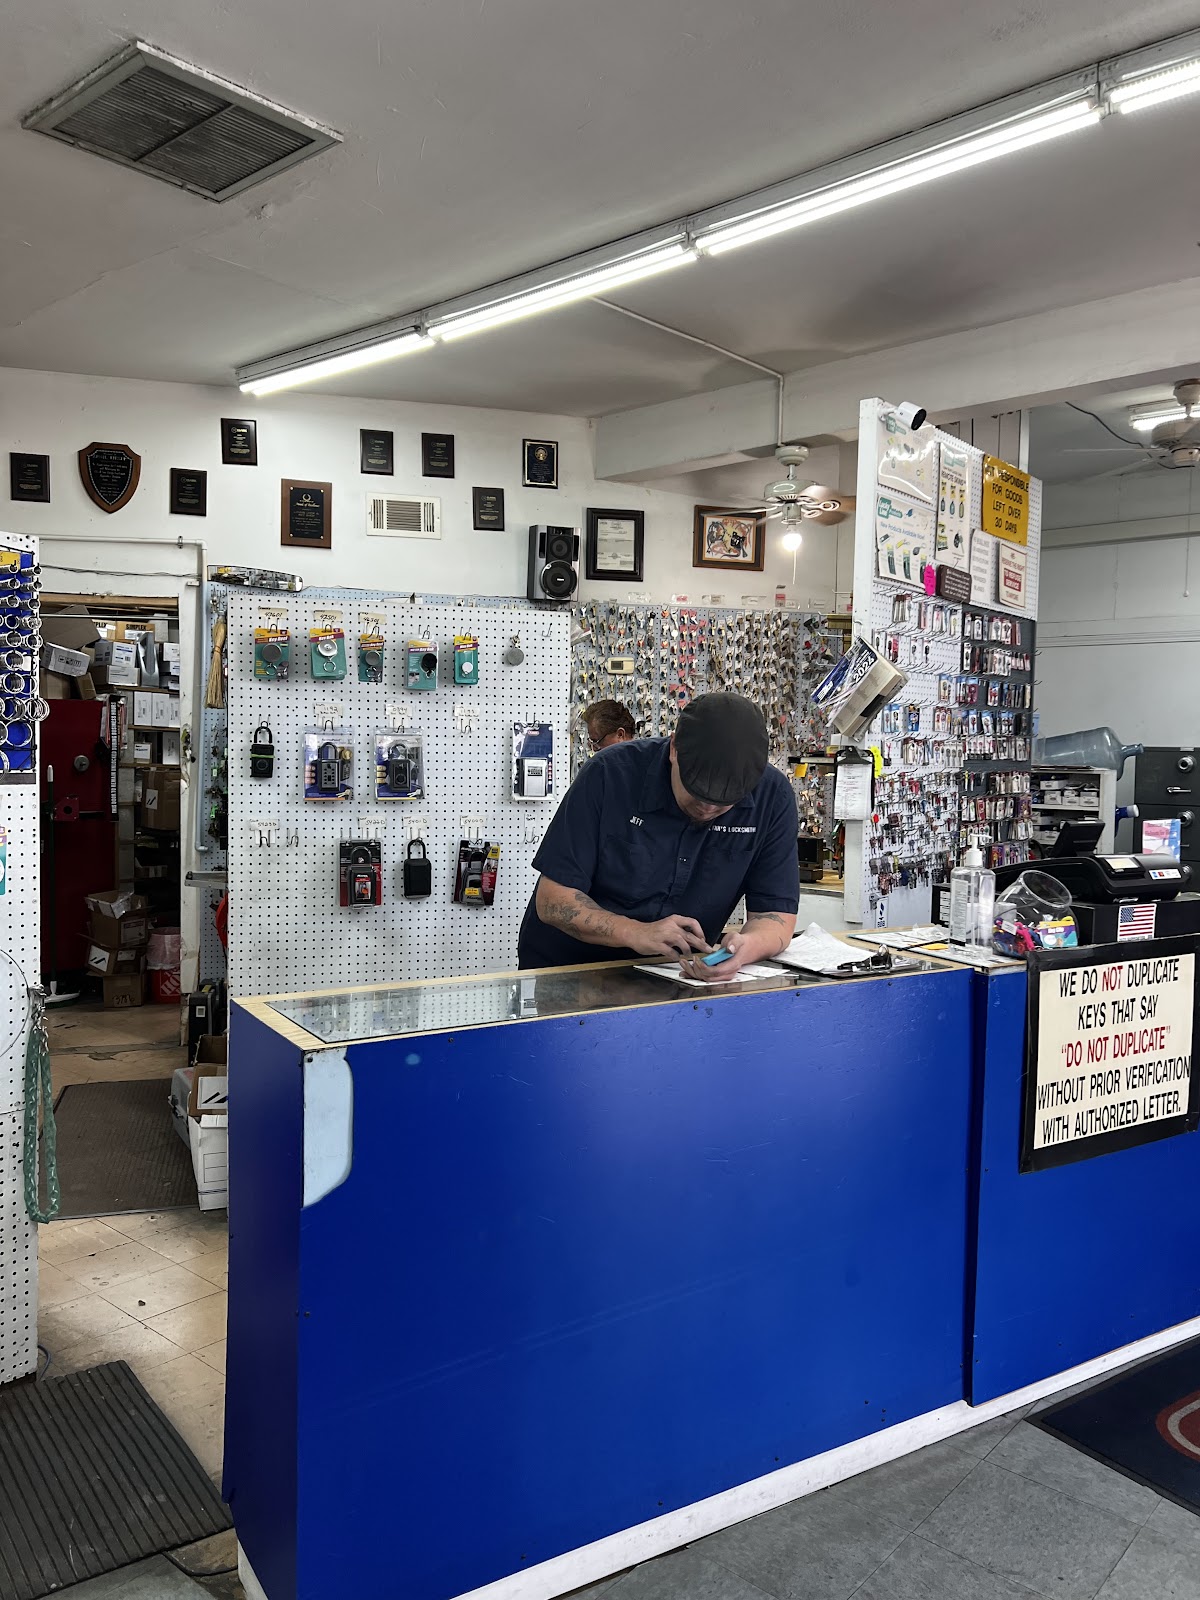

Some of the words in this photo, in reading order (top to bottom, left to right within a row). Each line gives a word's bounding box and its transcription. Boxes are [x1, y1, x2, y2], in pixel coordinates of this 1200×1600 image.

[992, 483, 1002, 496] FOR
[1005, 488, 1023, 504] GOODS
[993, 500, 1005, 513] LEFT
[1008, 506, 1021, 519] OVER
[995, 517, 1002, 528] 30
[1005, 520, 1017, 534] DAYS
[854, 656, 874, 682] 2024
[630, 816, 644, 826] JEFF
[1060, 971, 1077, 997] WE
[1082, 968, 1097, 994] DO
[1102, 966, 1123, 991] NOT
[1127, 958, 1180, 987] DUPLICATE
[1078, 1002, 1106, 1030] KEYS
[1112, 998, 1136, 1024] THAT
[1140, 994, 1158, 1020] SAY
[1087, 1036, 1109, 1064] NOT
[1037, 1076, 1085, 1110] WITHOUT
[1090, 1069, 1121, 1098] PRIOR
[1125, 1055, 1192, 1090] VERIFICATION
[1042, 1114, 1069, 1144] WITH
[1074, 1099, 1139, 1137] AUTHORIZED
[1143, 1090, 1181, 1120] LETTER.
